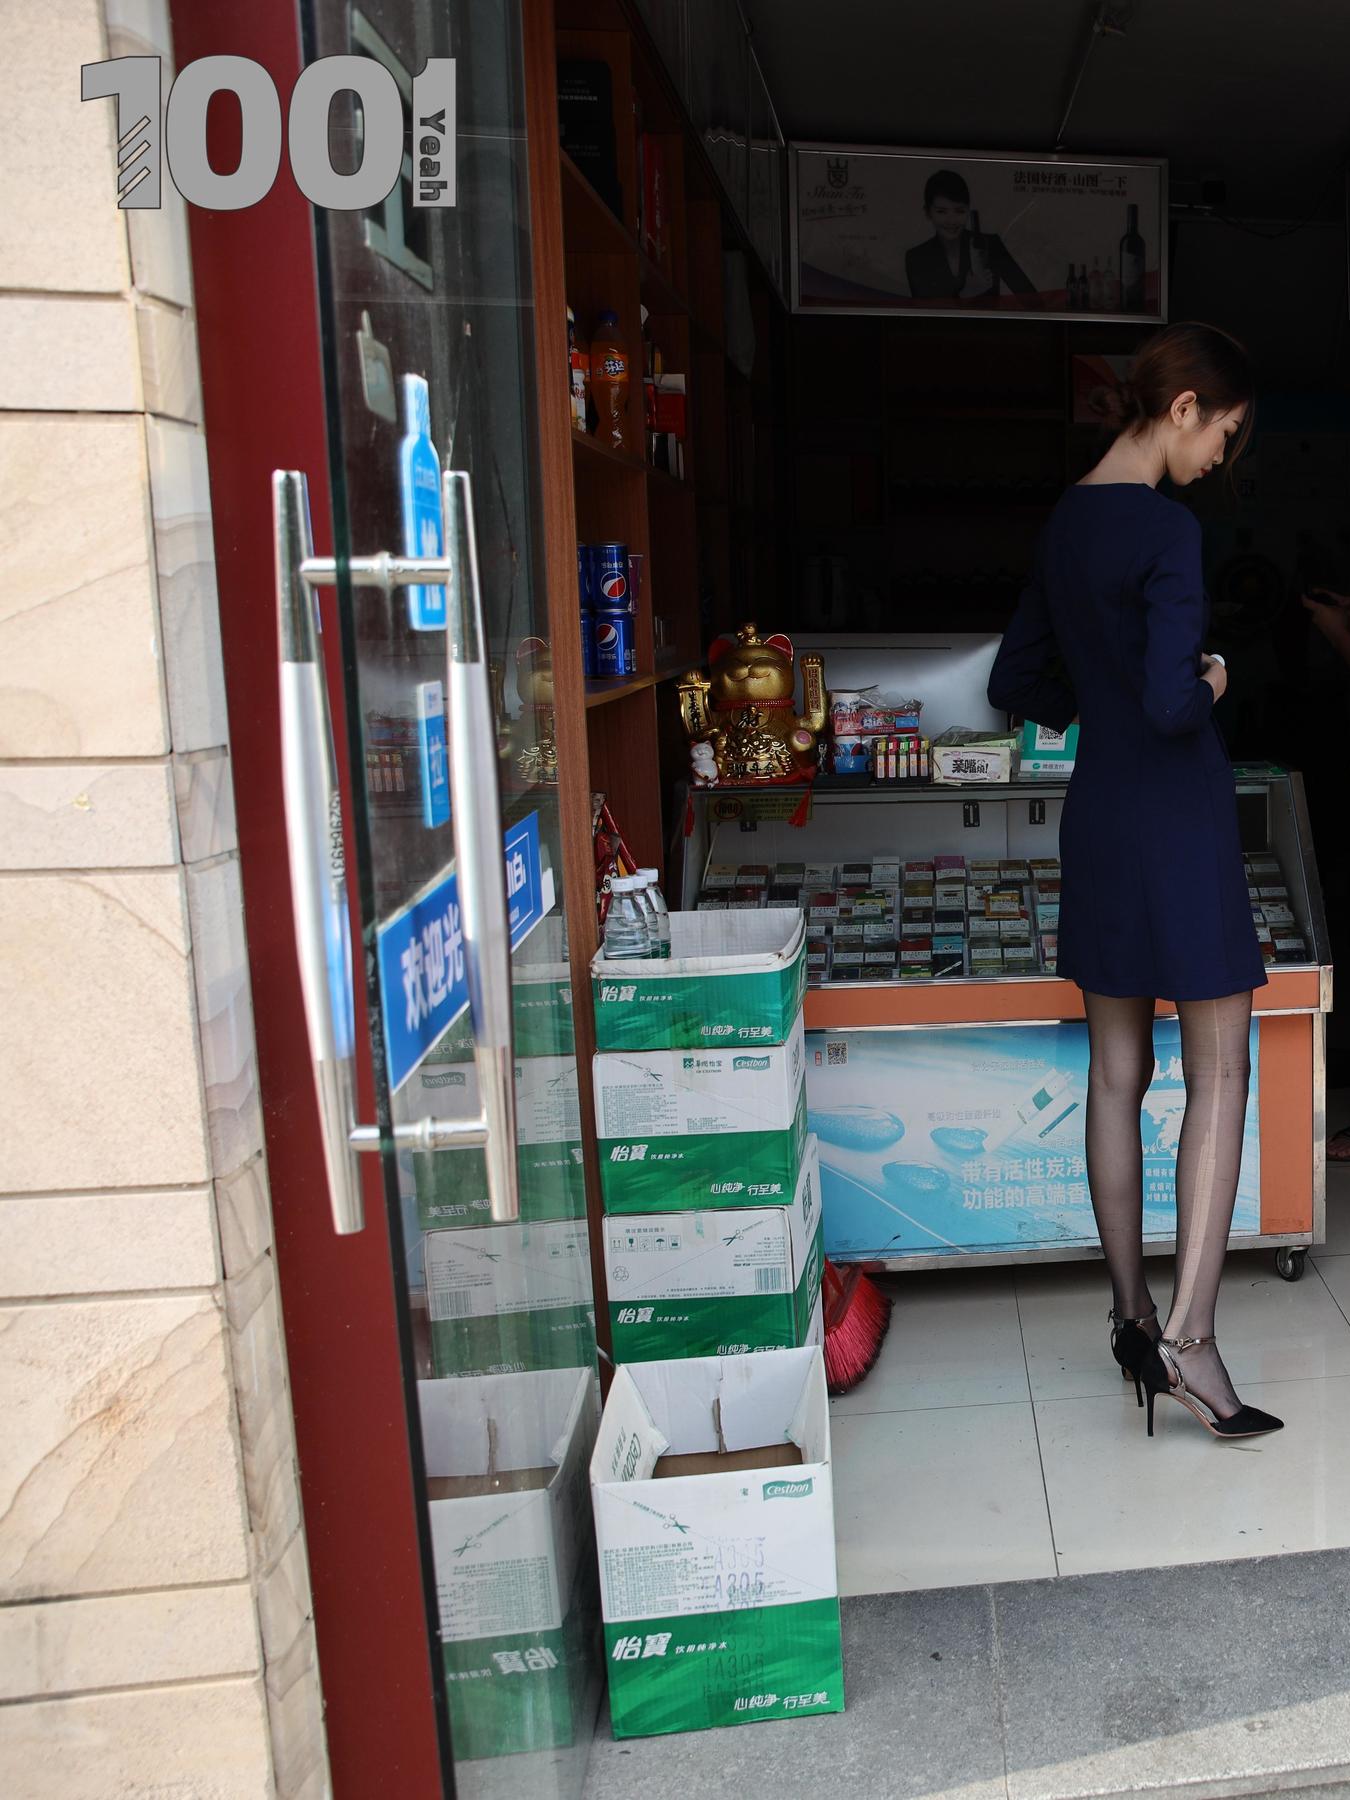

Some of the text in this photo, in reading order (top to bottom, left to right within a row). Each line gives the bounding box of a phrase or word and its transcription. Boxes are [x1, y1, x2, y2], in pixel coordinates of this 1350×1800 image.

[400, 903, 465, 1034] 欢迎光
[734, 1694, 780, 1711] 心纯净
